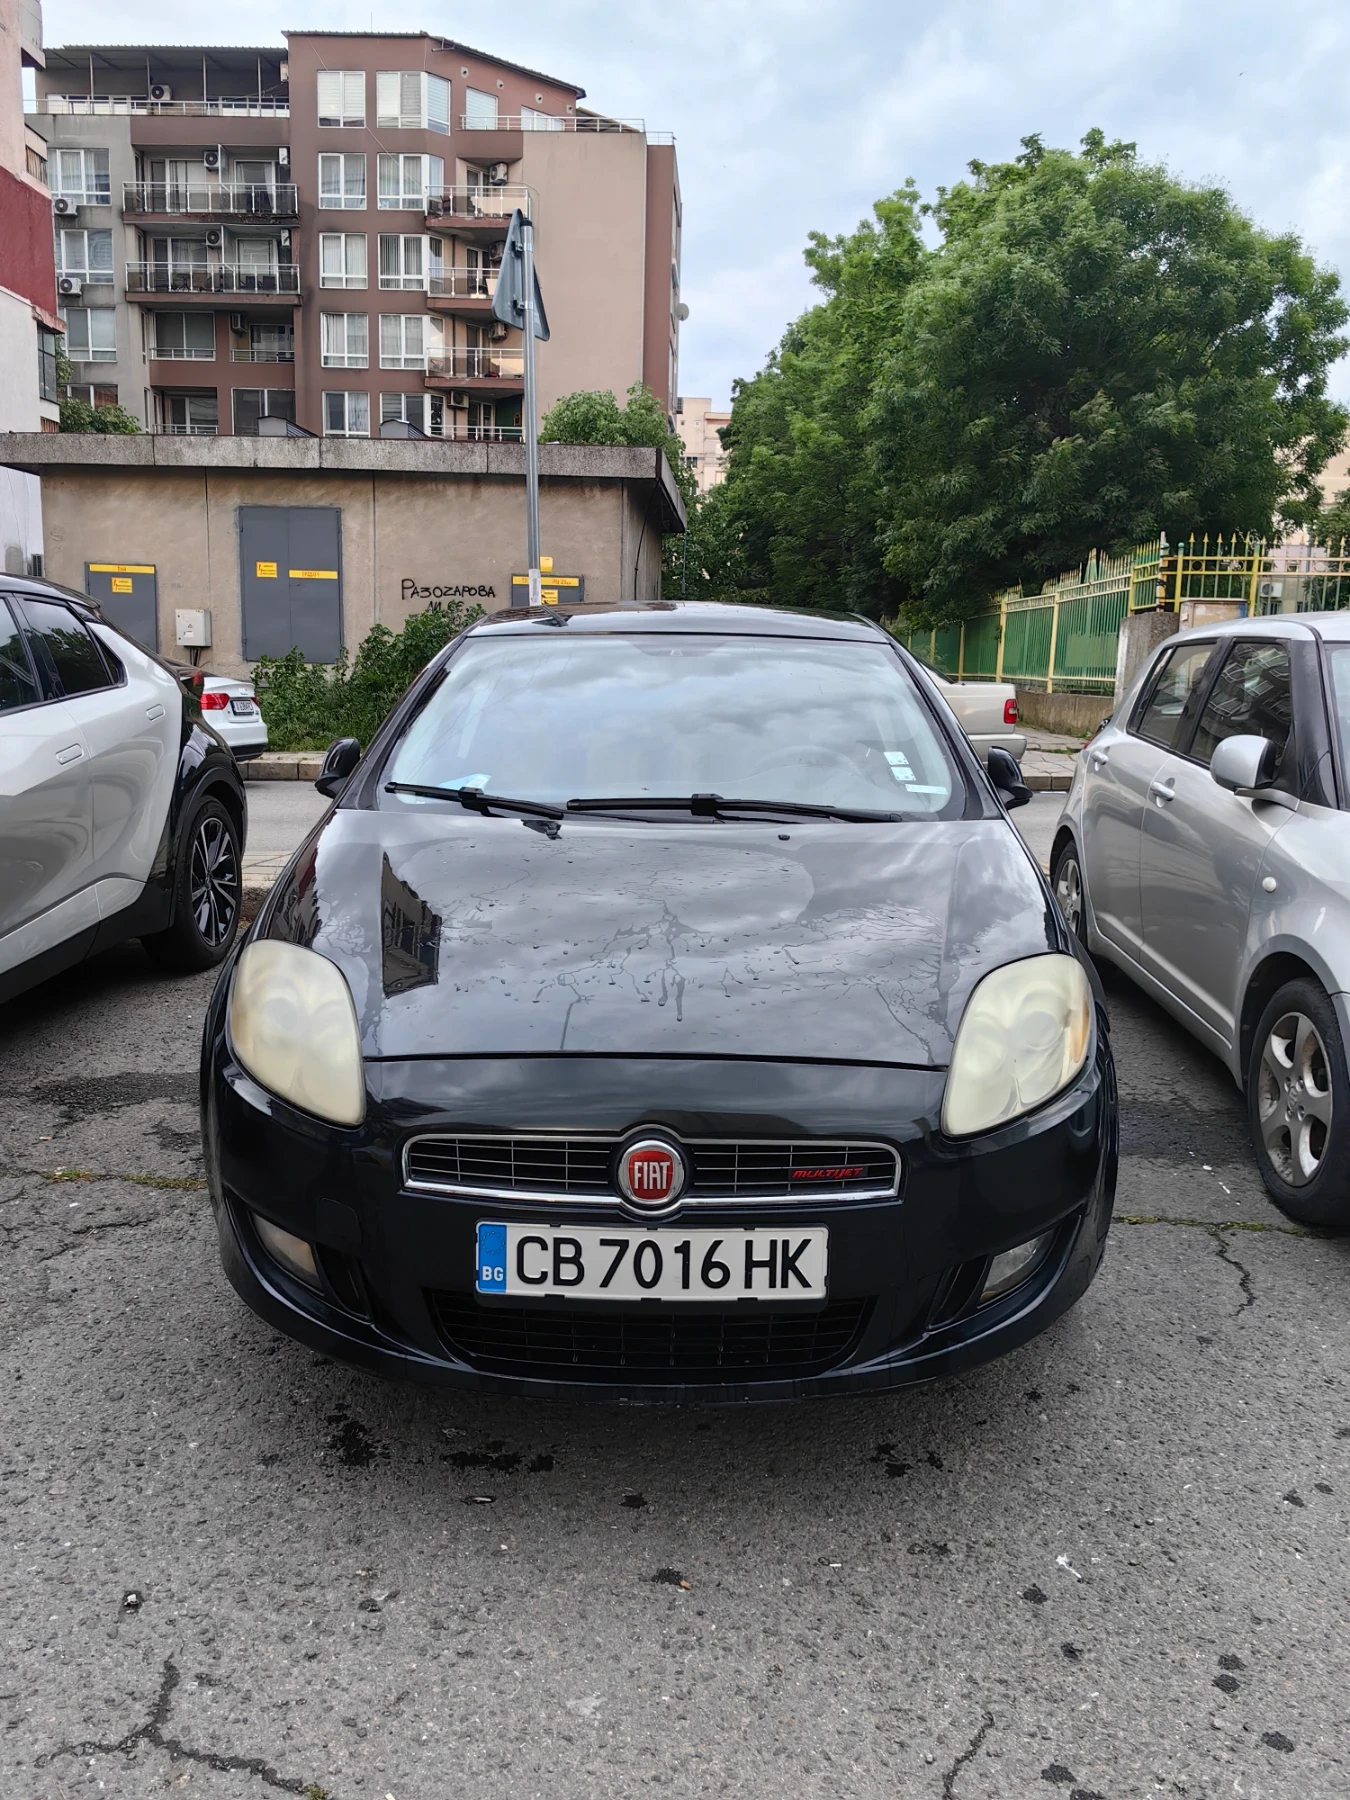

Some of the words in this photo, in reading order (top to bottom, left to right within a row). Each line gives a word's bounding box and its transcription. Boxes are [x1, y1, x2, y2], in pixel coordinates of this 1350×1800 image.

[633, 1161, 670, 1190] FIAT
[791, 1167, 864, 1181] MULTIJET
[482, 1265, 504, 1281] BG
[516, 1235, 585, 1287] CB
[599, 1239, 731, 1289] 7016
[744, 1238, 812, 1290] HK
